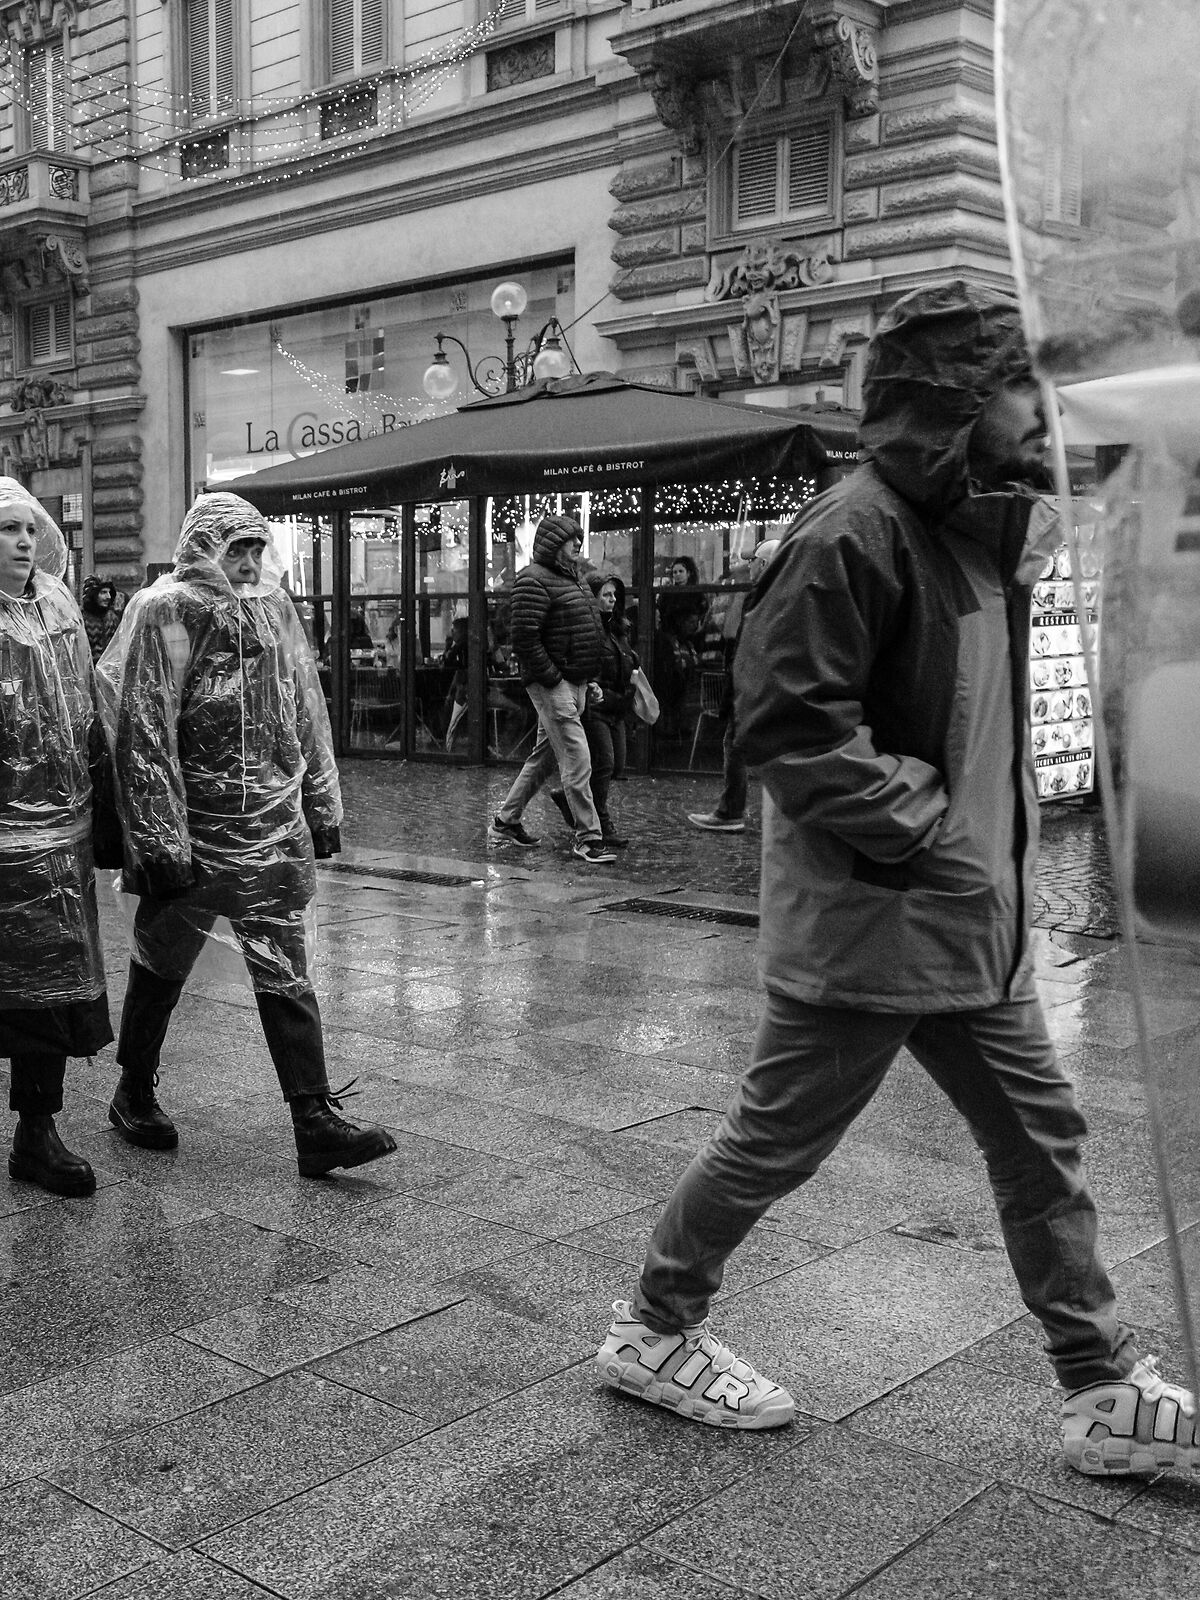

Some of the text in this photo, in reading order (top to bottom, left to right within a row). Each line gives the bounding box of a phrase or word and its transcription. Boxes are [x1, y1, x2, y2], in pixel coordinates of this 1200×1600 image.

[246, 422, 280, 454] La
[286, 411, 362, 460] Cassa
[826, 450, 843, 459] MILAN
[543, 467, 569, 476] MILAN
[596, 464, 603, 472] &
[606, 461, 645, 471] BISTROT
[338, 486, 368, 496] BISTROT
